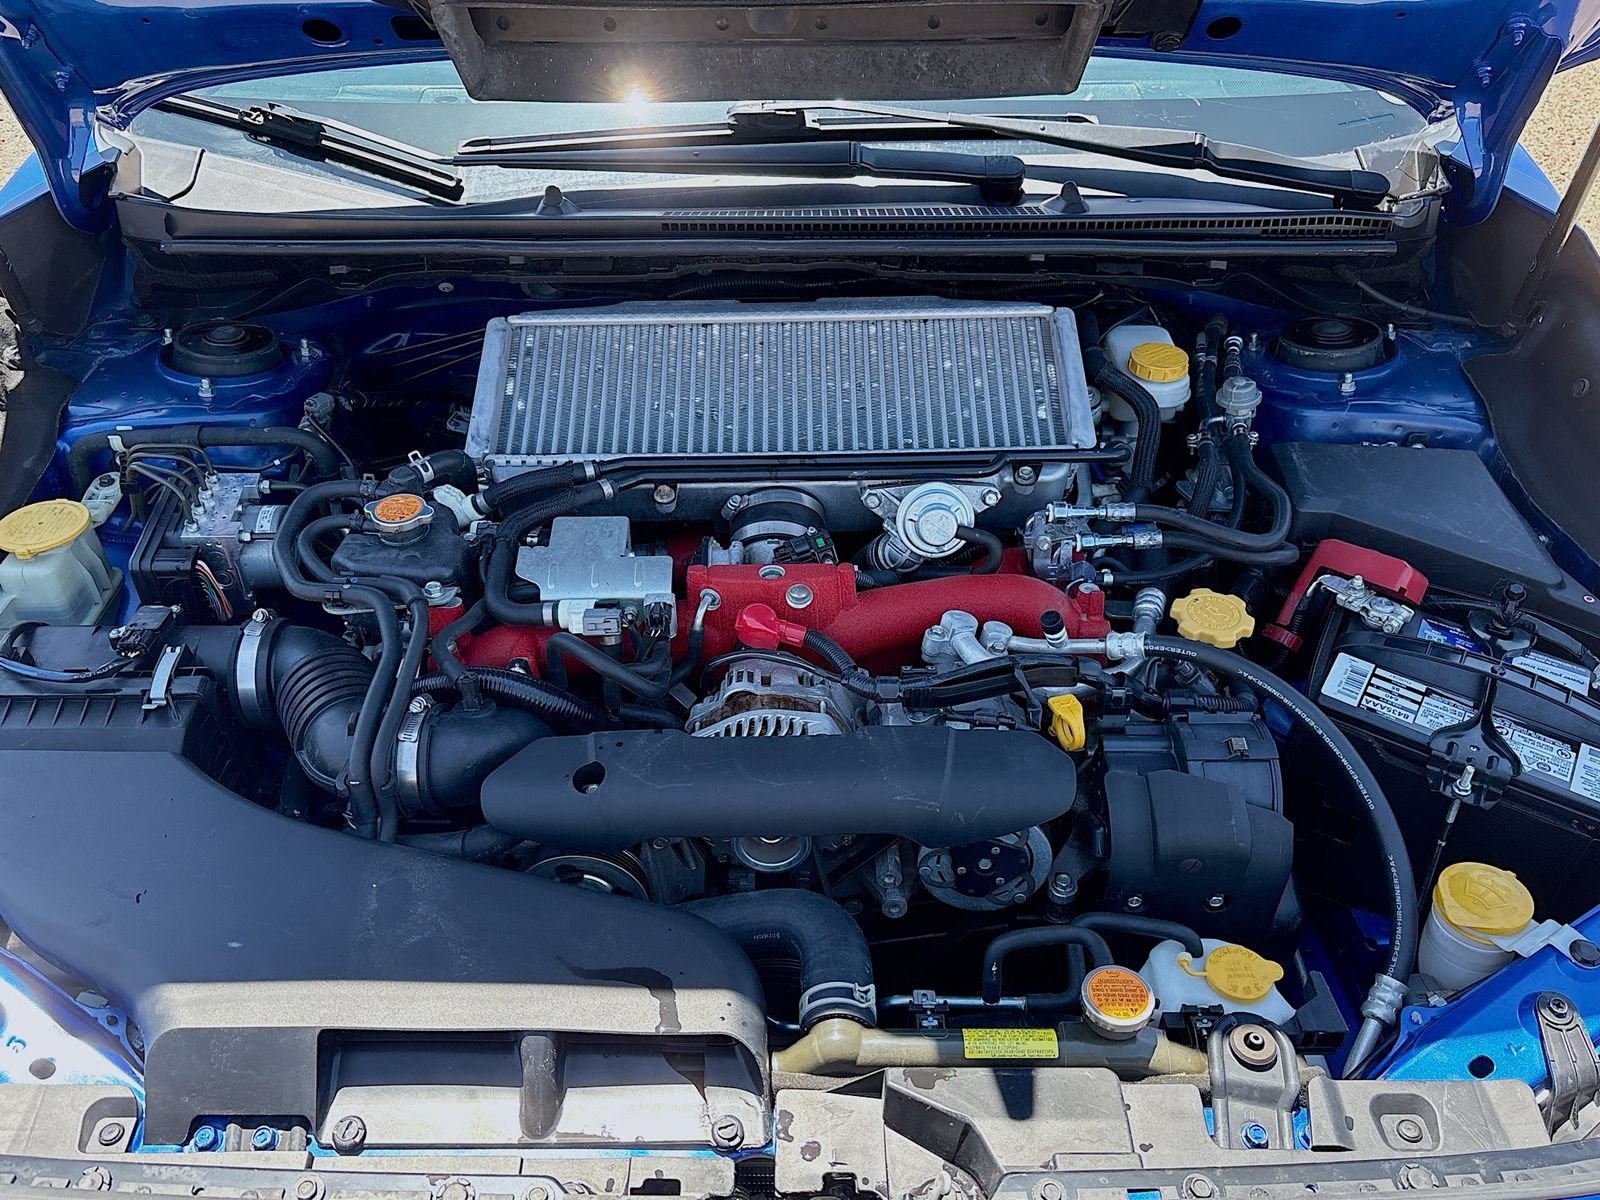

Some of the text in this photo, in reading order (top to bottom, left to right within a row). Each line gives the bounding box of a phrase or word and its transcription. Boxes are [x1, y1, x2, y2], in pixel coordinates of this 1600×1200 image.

[1563, 675, 1585, 685] Power
[1384, 693, 1399, 701] 640
[1365, 698, 1410, 720] 8435AAA
